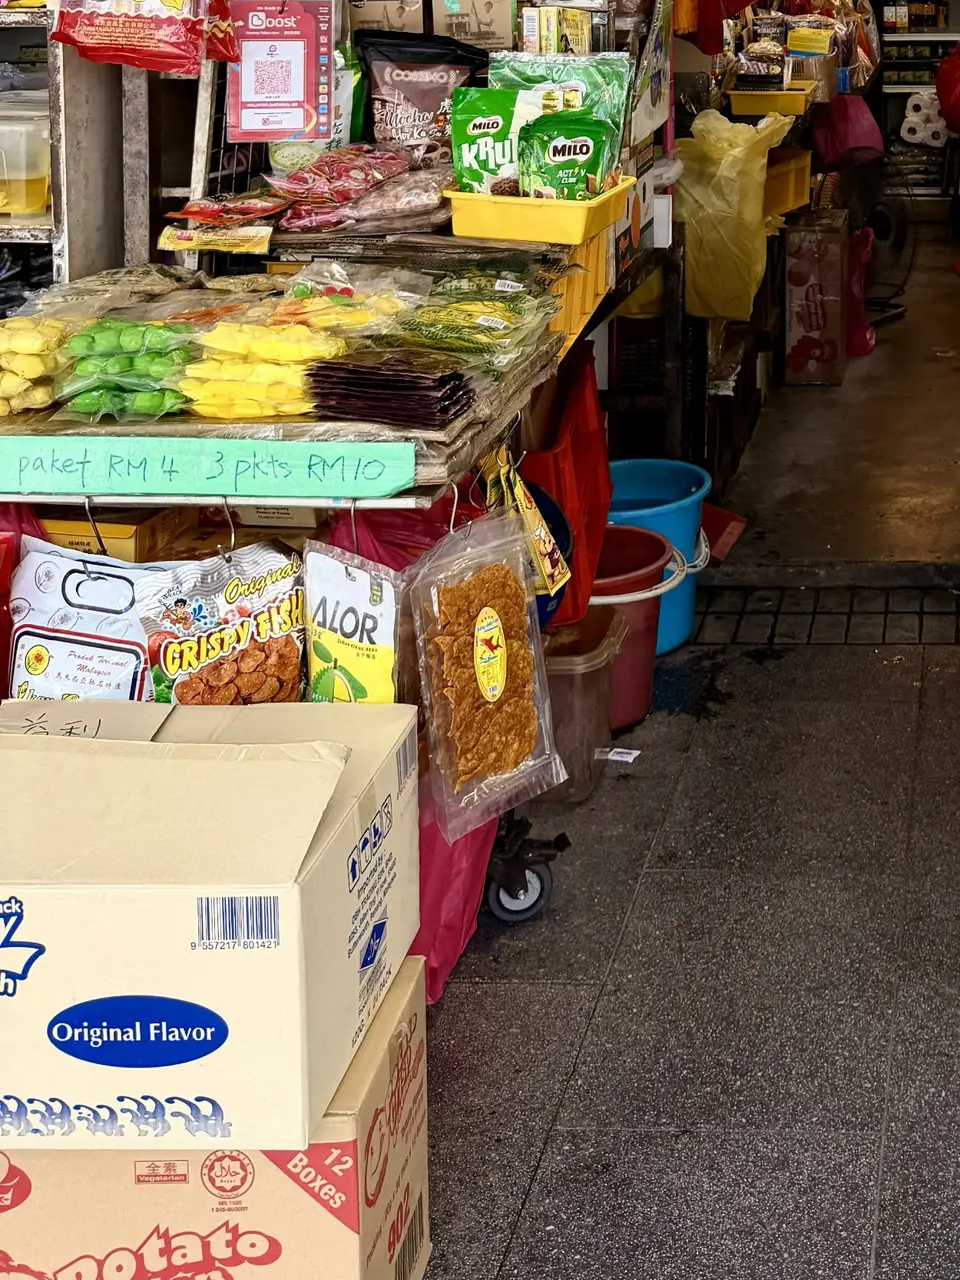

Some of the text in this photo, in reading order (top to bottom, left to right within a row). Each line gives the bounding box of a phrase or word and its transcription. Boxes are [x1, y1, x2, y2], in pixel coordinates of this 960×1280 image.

[376, 108, 434, 128] Mocha
[471, 120, 499, 132] MILO
[552, 144, 590, 158] MILO
[18, 448, 91, 488] paket
[205, 450, 225, 480] 3
[234, 450, 293, 489] pkts
[224, 553, 300, 604] Original
[165, 588, 305, 676] CRISPY FISH
[312, 595, 377, 645] ALOR
[76, 663, 111, 676] Malaysia
[201, 941, 237, 950] 557217
[242, 940, 278, 950] 801421
[52, 1020, 215, 1048] Original Flavor
[145, 1162, 178, 1174] 全素
[323, 1147, 354, 1177] 12
[138, 1174, 185, 1182] Vegetarian
[286, 1152, 347, 1209] Boxes
